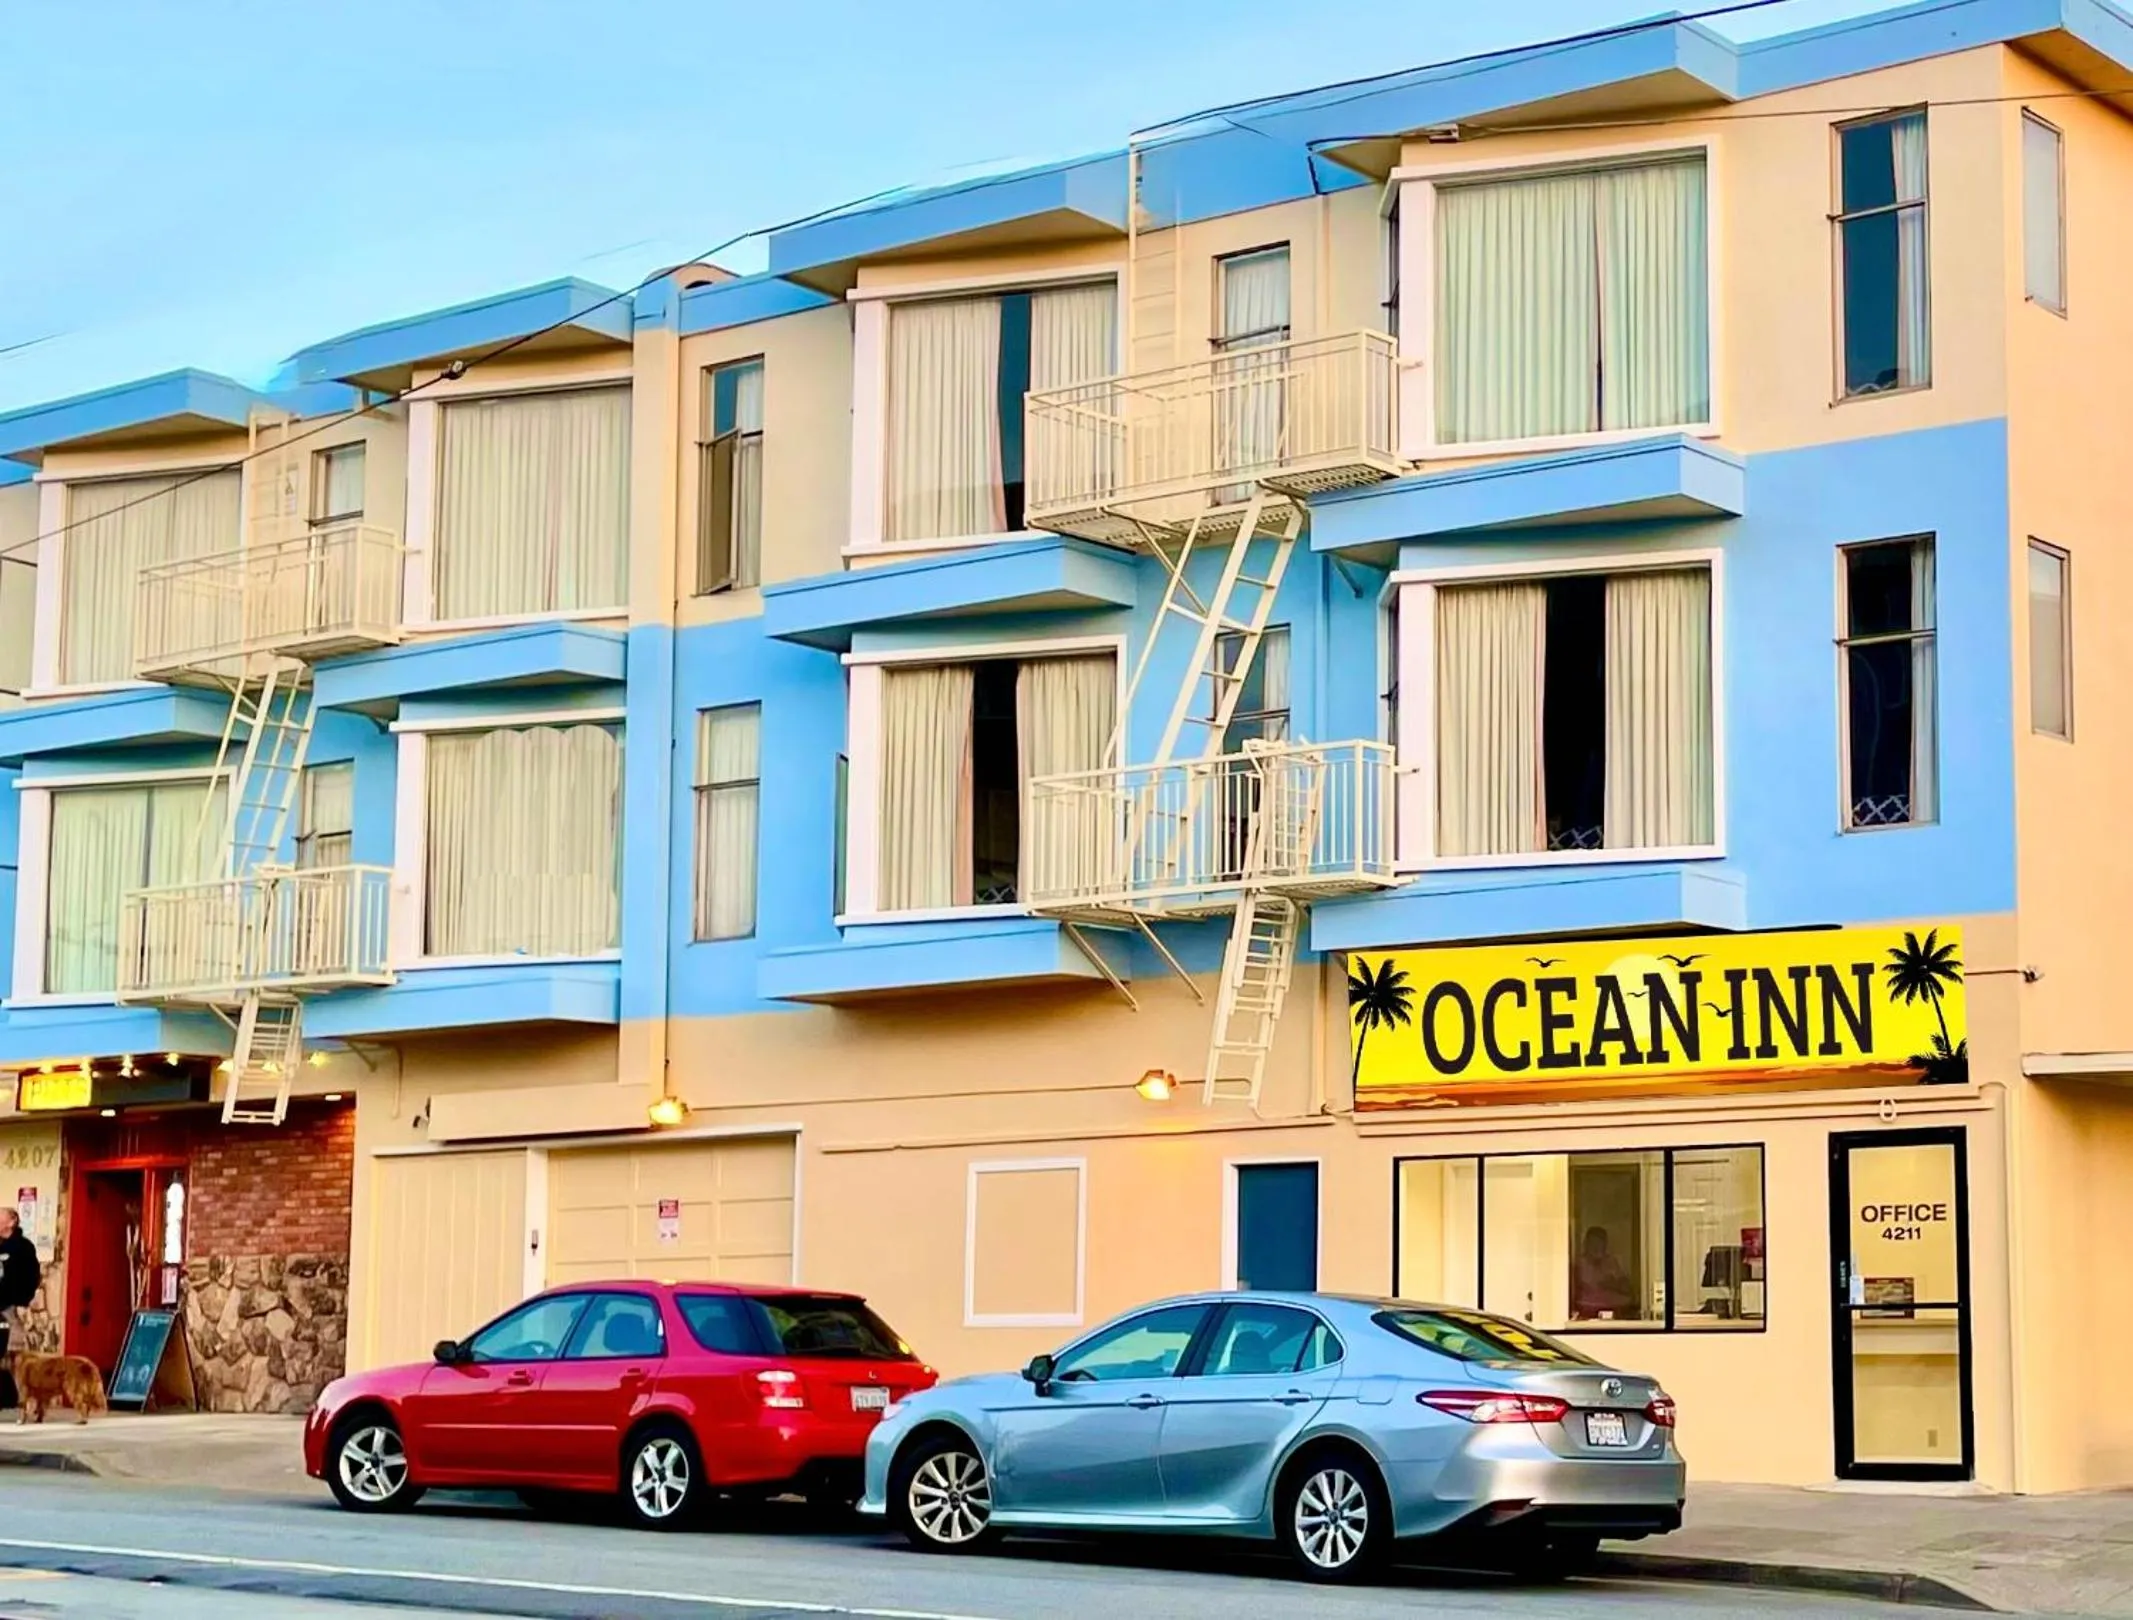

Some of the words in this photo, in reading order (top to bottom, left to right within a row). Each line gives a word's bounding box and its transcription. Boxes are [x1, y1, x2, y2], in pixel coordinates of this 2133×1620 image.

[1422, 970, 1702, 1075] OCEAN
[1724, 962, 1875, 1060] INN
[5, 1145, 57, 1169] 4207
[1860, 1203, 1947, 1223] OFFICE
[1881, 1226, 1922, 1241] 4211
